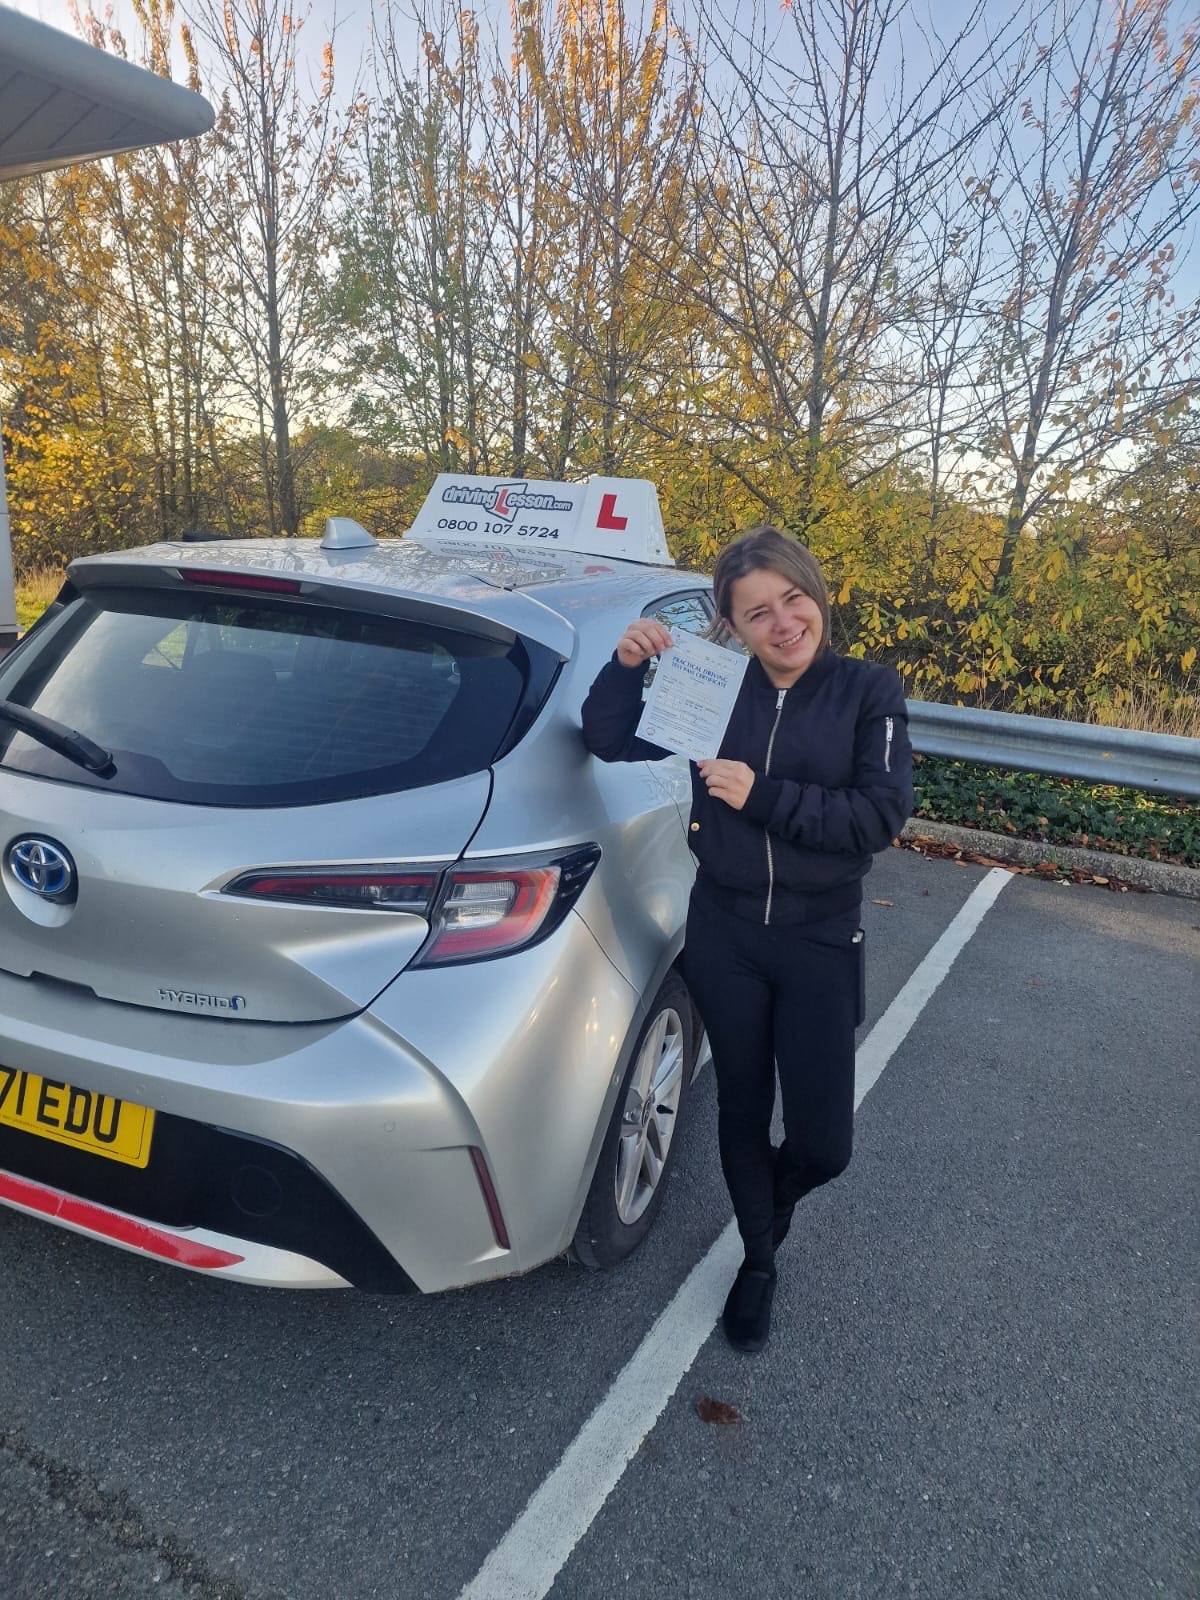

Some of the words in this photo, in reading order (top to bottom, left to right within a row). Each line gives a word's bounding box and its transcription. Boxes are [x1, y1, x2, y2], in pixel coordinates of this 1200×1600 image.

[596, 493, 629, 531] L
[437, 518, 478, 532] 0800
[483, 521, 513, 535] 107
[518, 525, 559, 539] 5724
[672, 656, 701, 673] PRACTICAL
[703, 667, 729, 682] DRIVING
[683, 666, 695, 676] PASS
[695, 672, 728, 688] CERTIFICATE
[156, 988, 230, 1009] HYBRID
